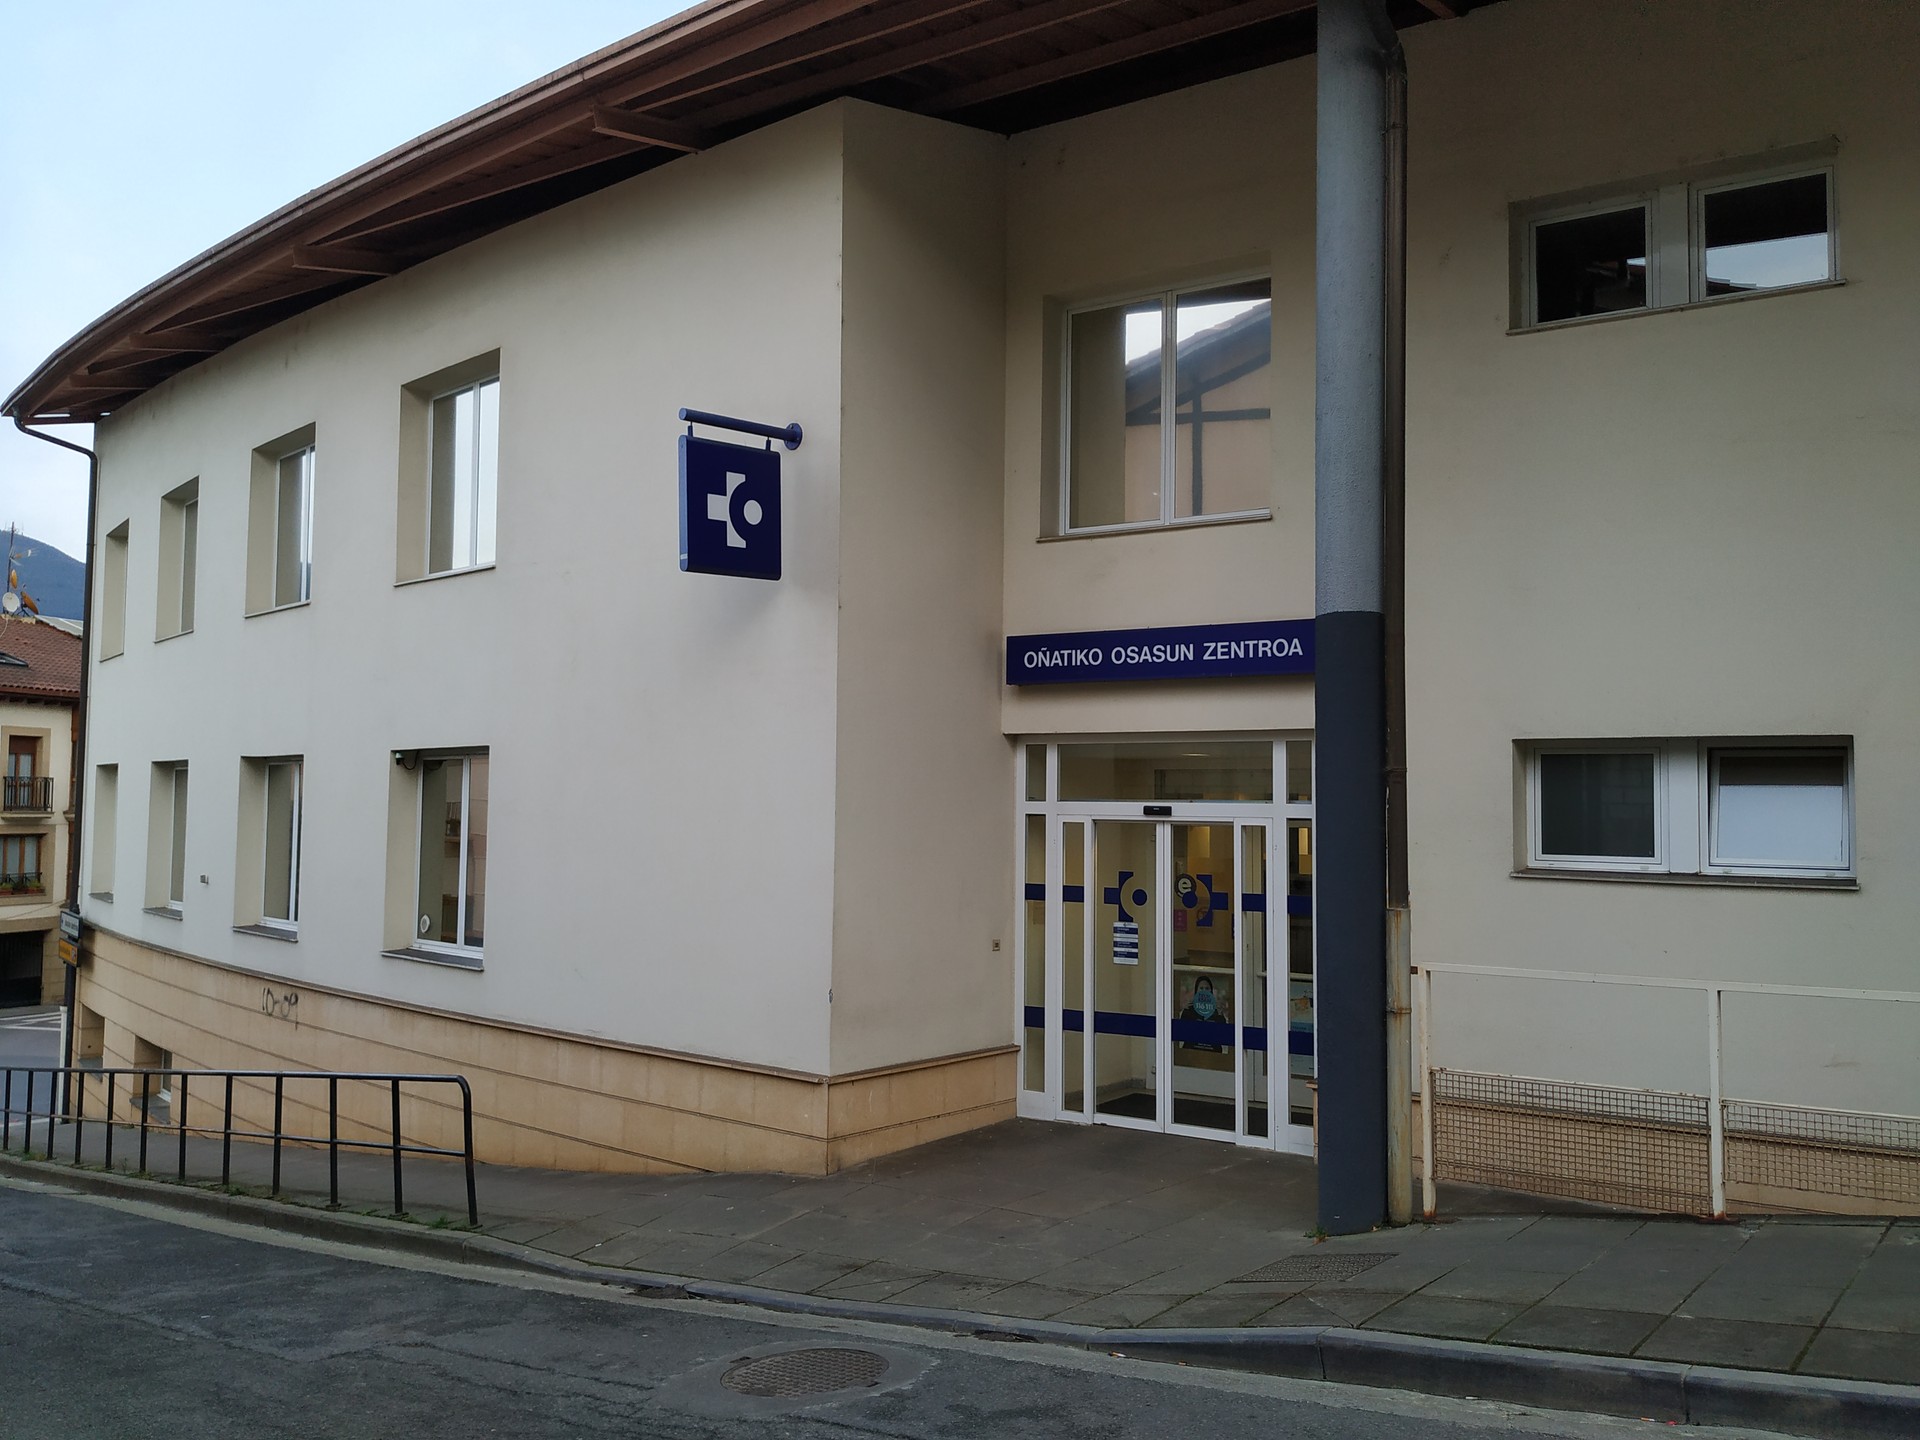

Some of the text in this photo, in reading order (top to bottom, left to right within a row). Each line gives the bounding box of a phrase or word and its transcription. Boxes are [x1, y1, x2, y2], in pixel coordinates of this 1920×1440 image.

[1023, 638, 1303, 668] OÑATIKO OSASUN ZENTROA
